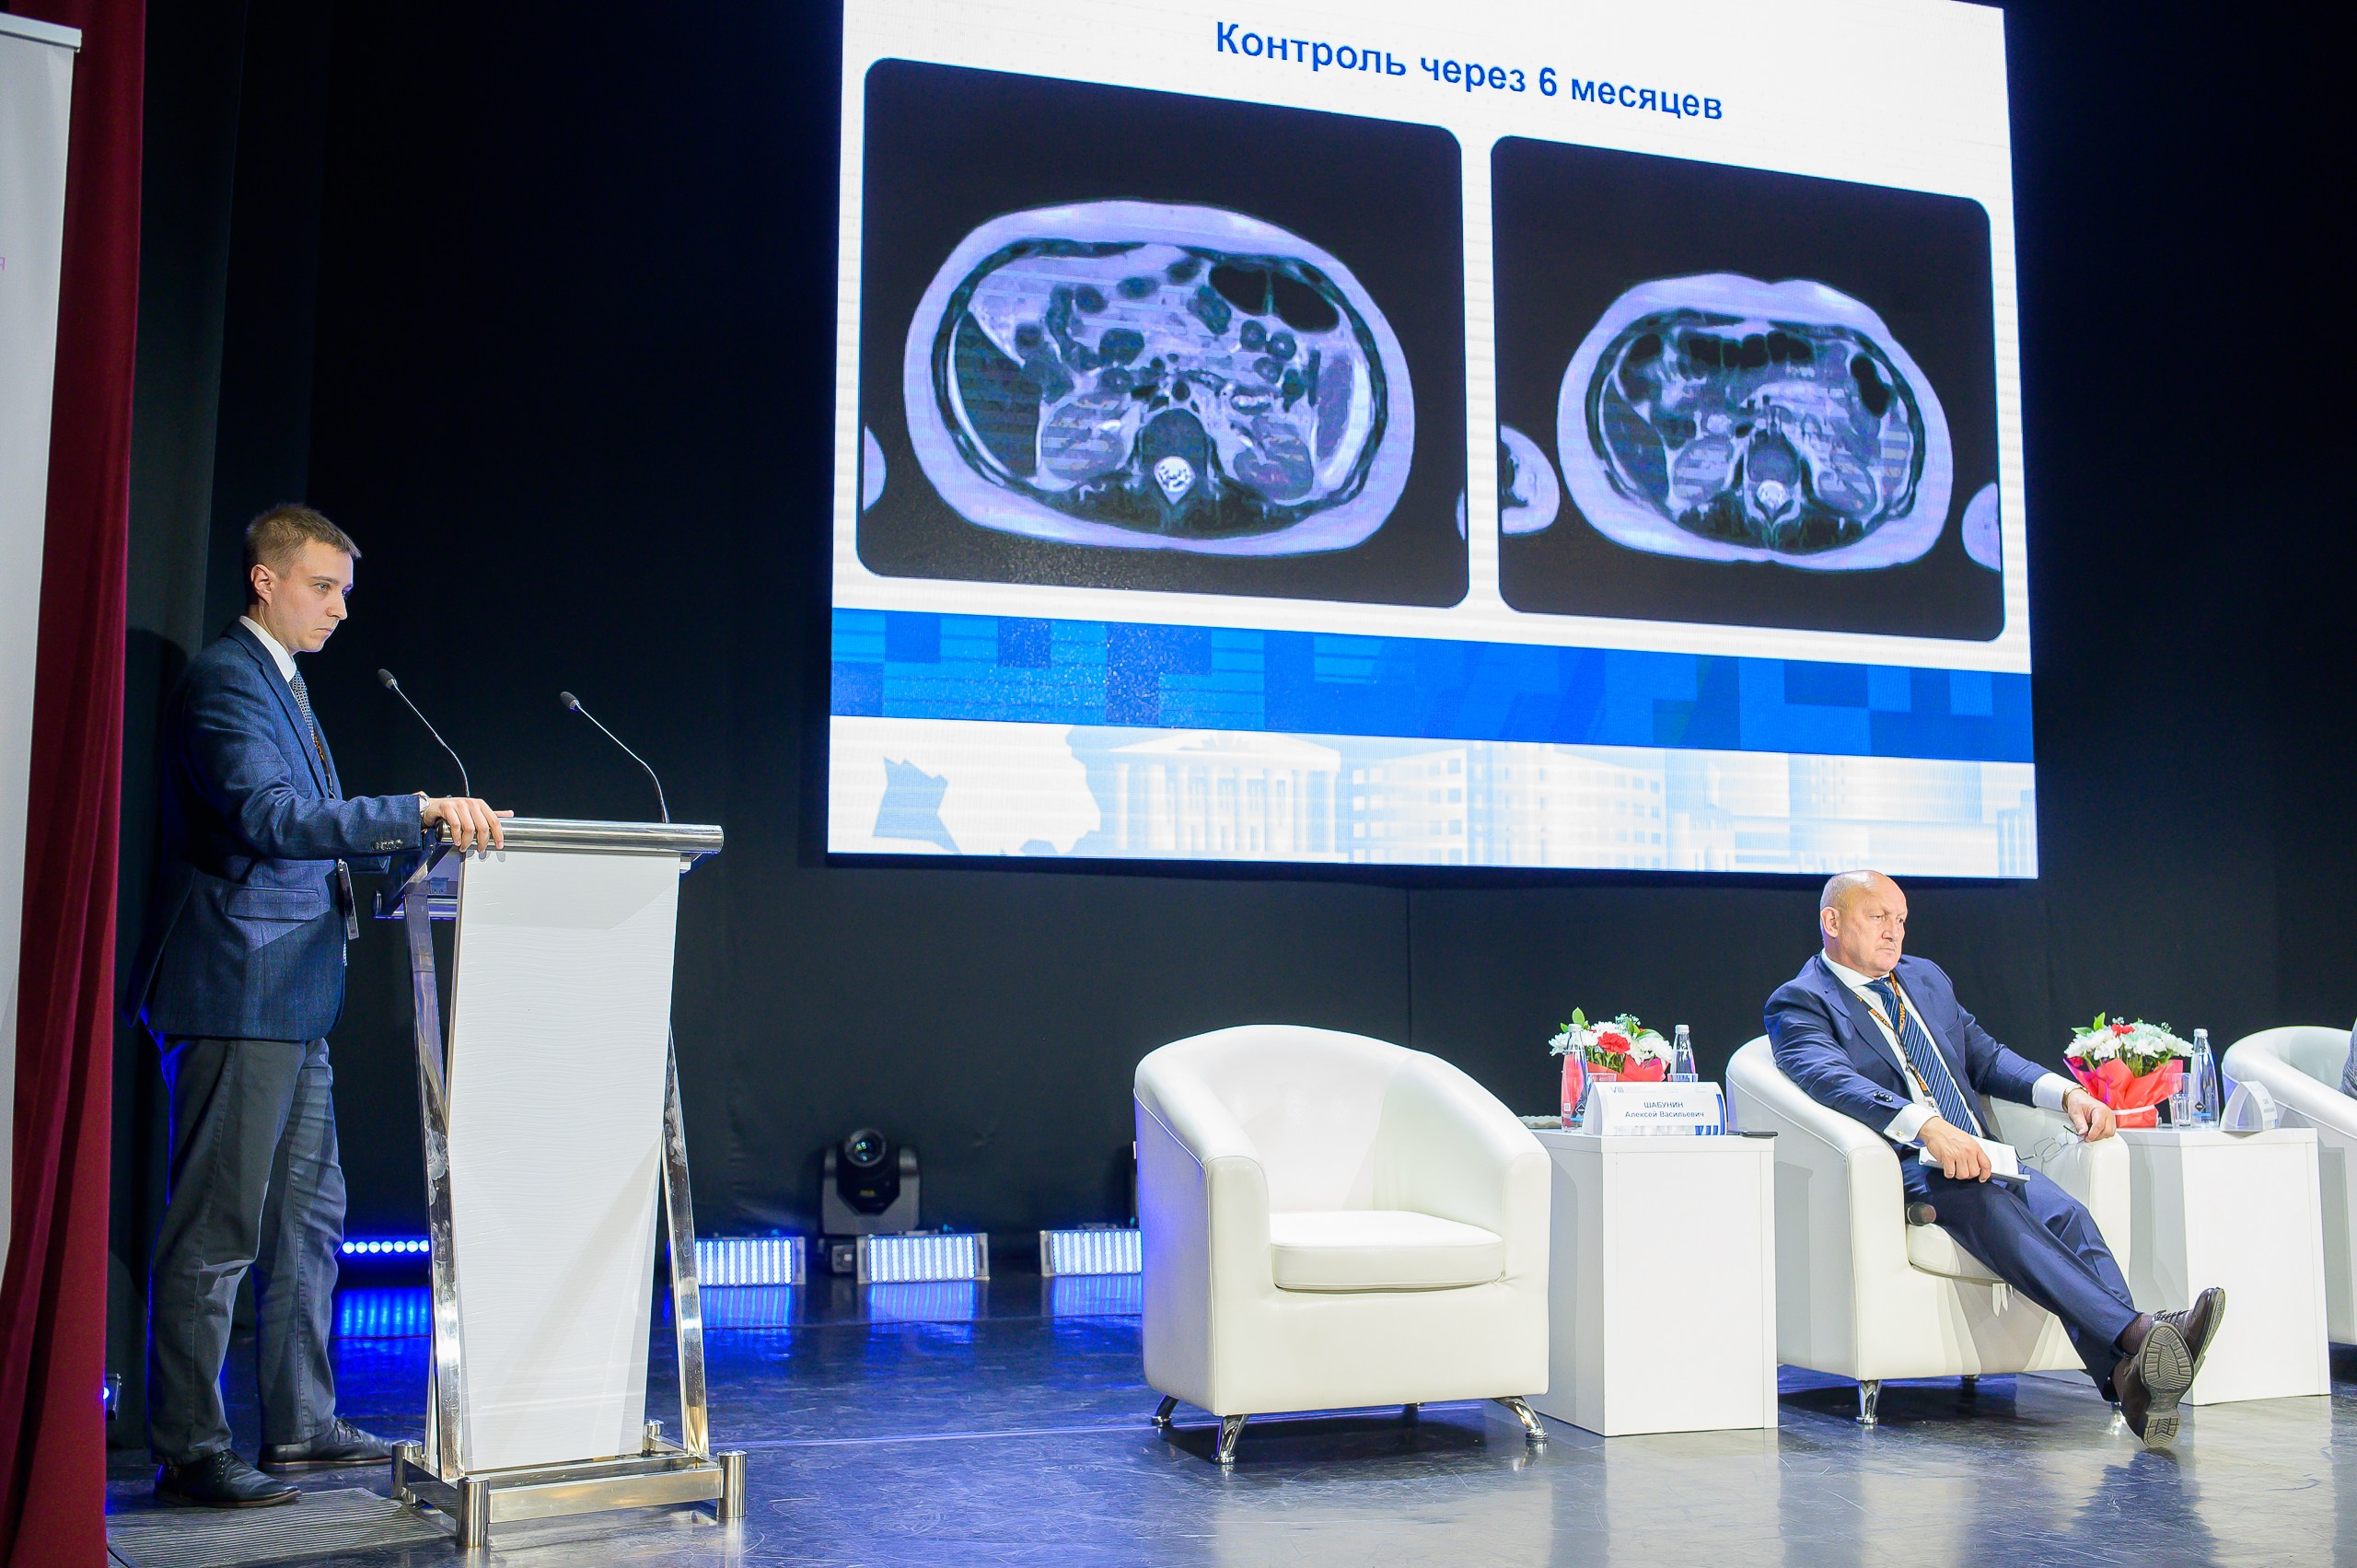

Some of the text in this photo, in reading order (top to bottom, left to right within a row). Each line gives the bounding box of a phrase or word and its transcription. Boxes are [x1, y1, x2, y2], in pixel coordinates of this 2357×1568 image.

[1216, 21, 1723, 120] Контроль через 6 месяцев
